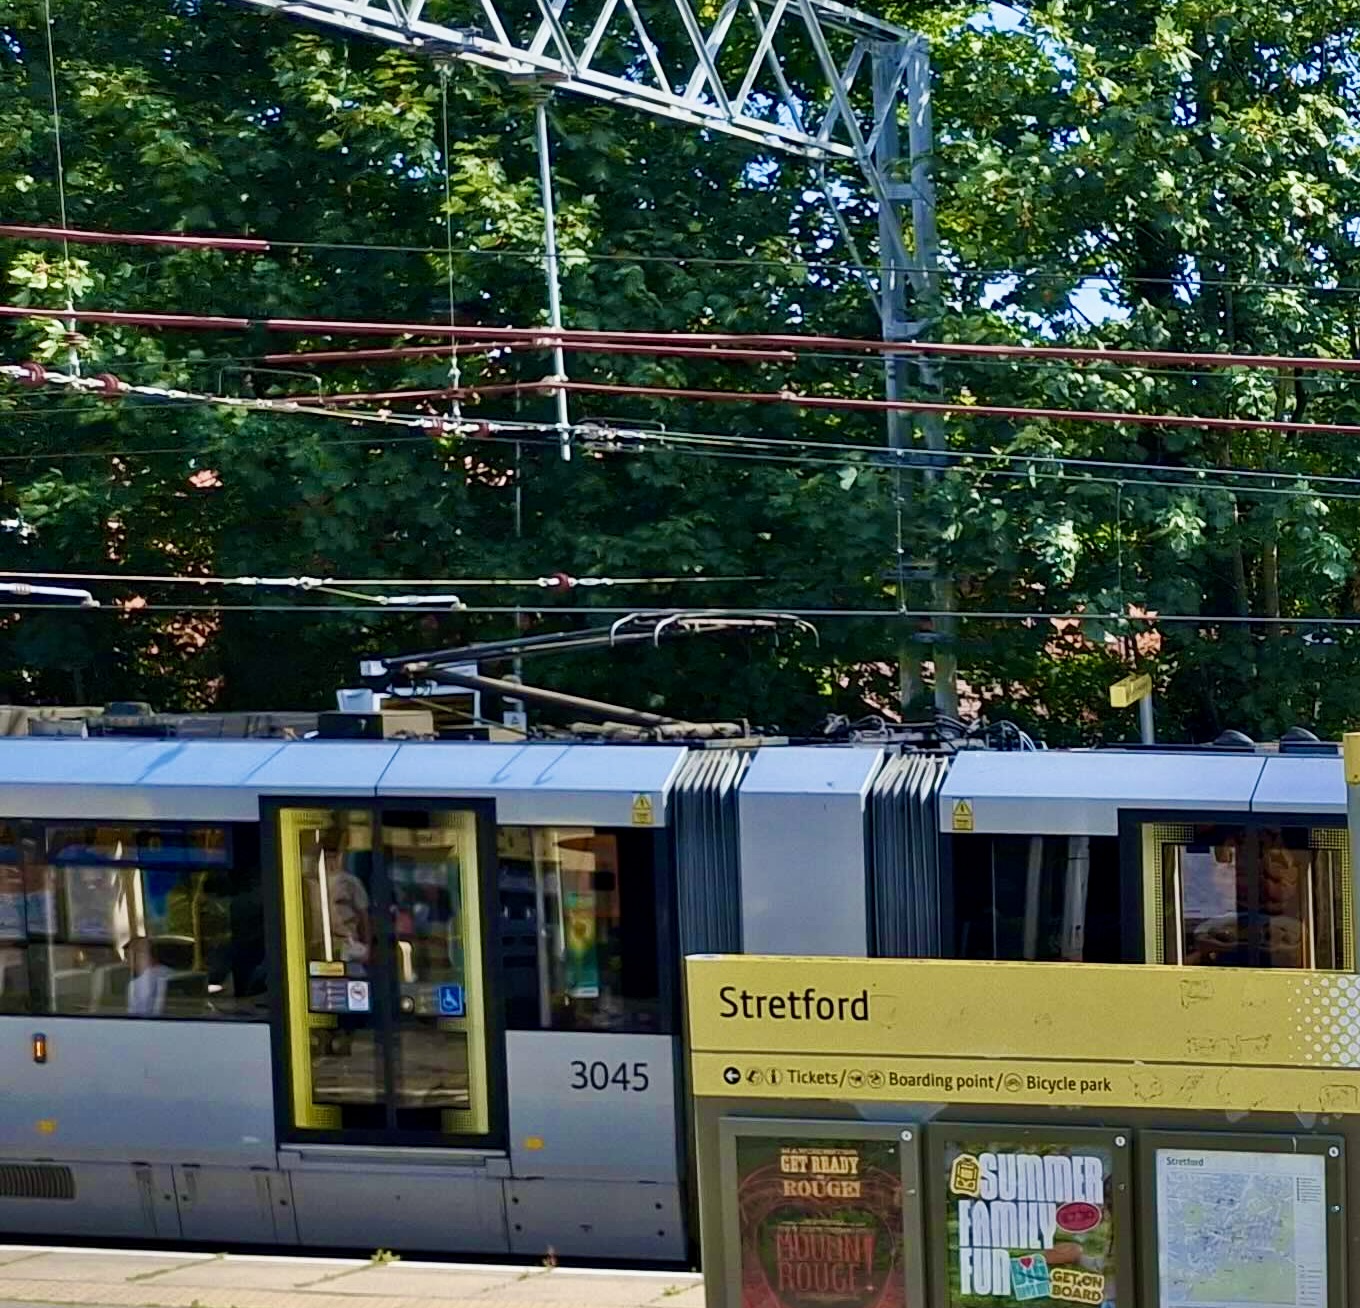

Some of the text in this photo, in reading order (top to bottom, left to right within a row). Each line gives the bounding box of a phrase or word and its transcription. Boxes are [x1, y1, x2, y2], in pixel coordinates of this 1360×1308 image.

[719, 985, 869, 1021] Stretford
[570, 1060, 649, 1092] 3045
[888, 1071, 953, 1092] Boarding
[1026, 1074, 1077, 1095] Bicycle
[1080, 1077, 1112, 1095] park
[780, 1155, 860, 1175] GET READY
[1165, 1155, 1205, 1167] Stretford
[978, 1152, 1105, 1204] SUMMER
[958, 1199, 1057, 1250] FAMILY
[958, 1247, 1012, 1296] FUN
[1052, 1270, 1103, 1289] GET ON
[1052, 1284, 1102, 1302] BOARD
